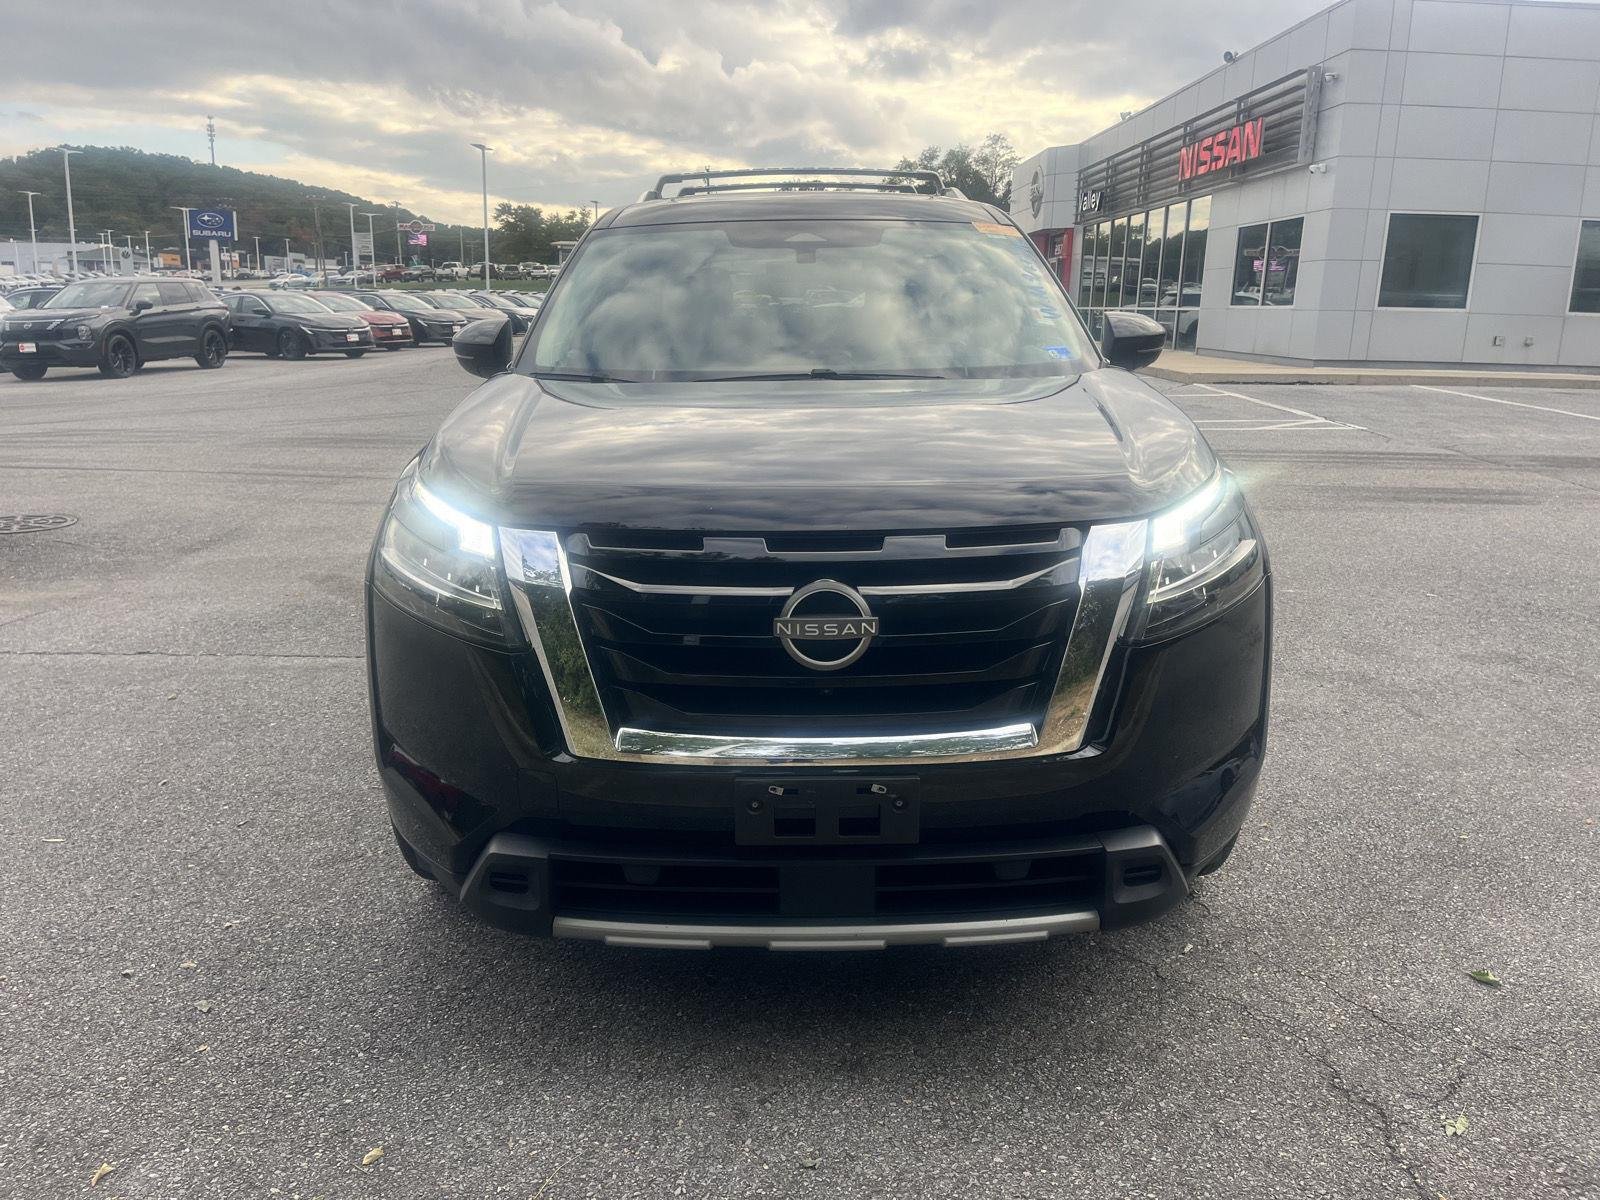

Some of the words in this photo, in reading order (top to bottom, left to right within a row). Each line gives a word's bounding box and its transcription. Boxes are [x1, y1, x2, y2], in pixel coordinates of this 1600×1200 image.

[1178, 116, 1263, 181] NISSAN
[192, 229, 231, 237] SUBARU
[776, 622, 876, 636] NISSAN
